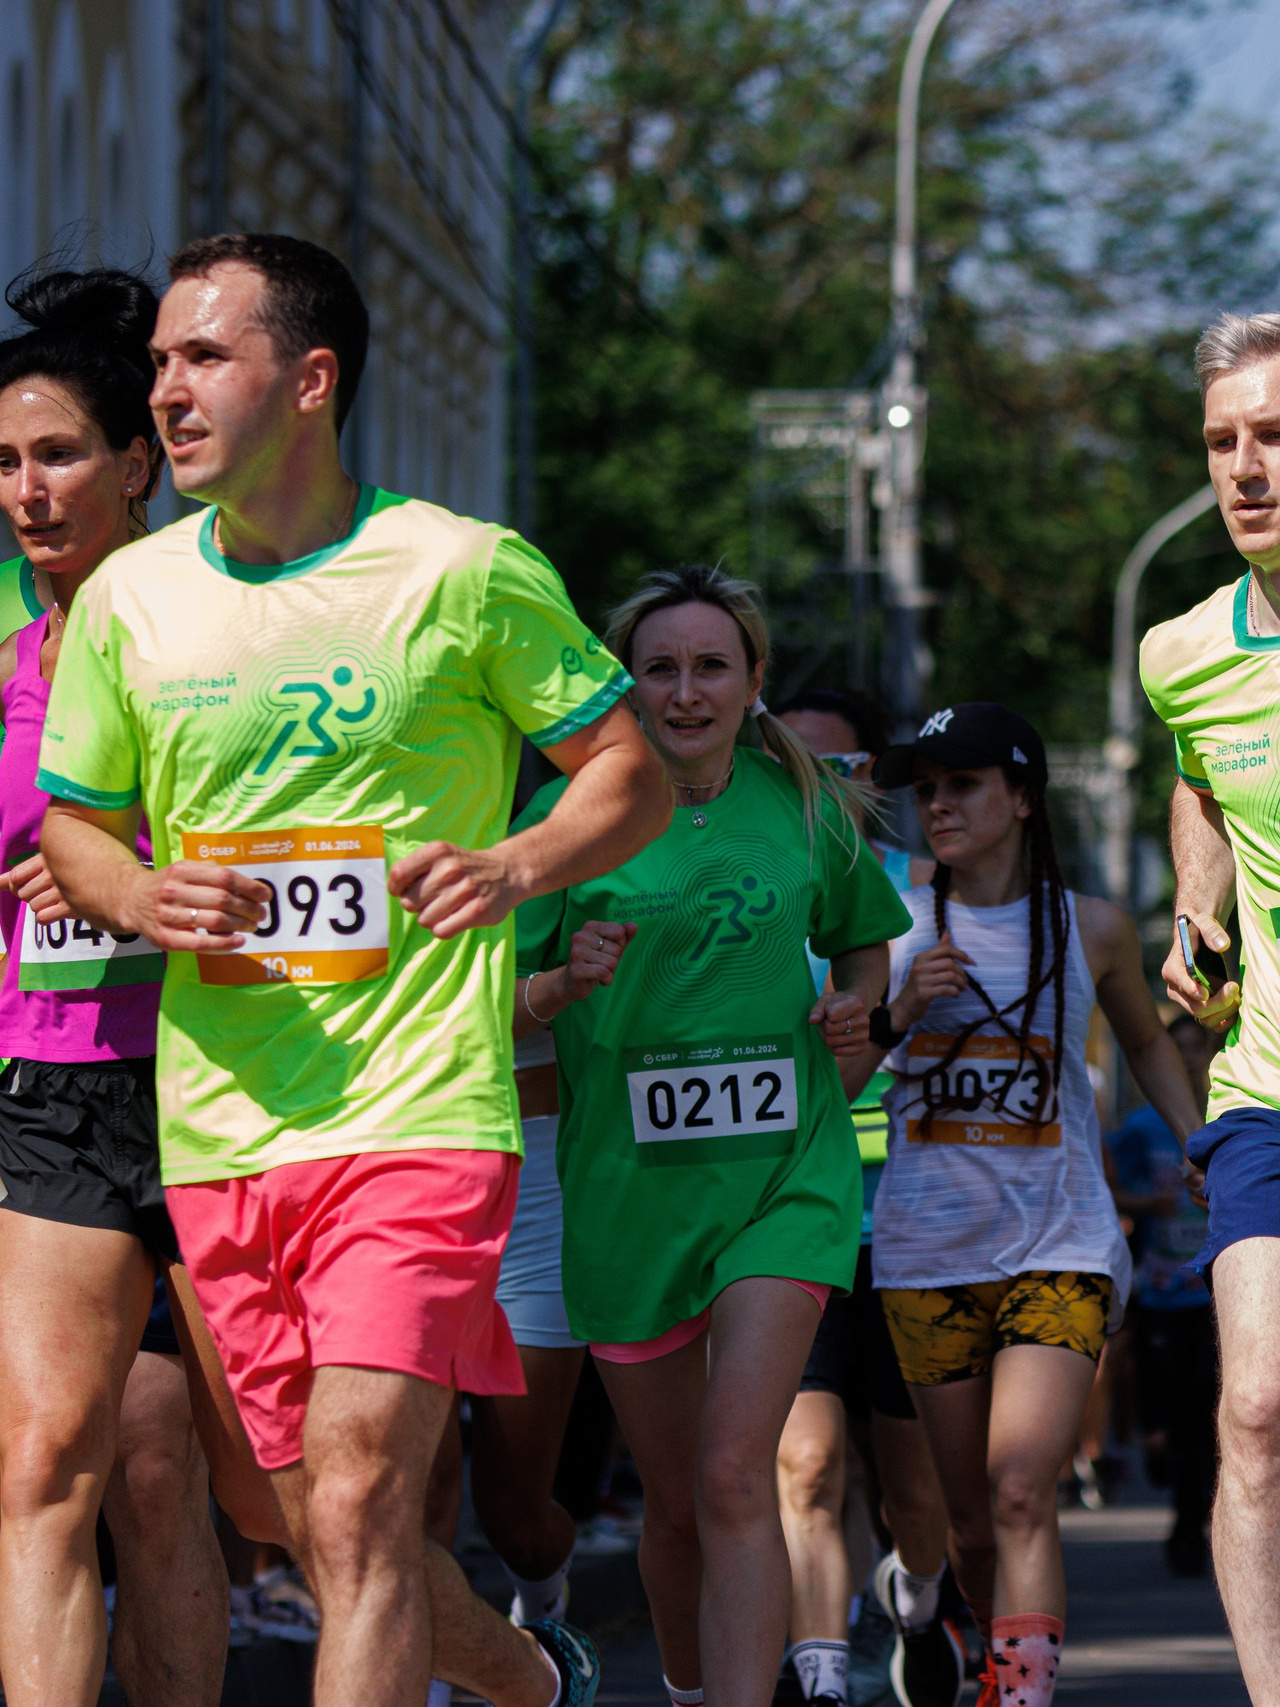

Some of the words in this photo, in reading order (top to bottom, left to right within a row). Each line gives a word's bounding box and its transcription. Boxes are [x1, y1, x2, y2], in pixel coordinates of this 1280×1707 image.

[157, 671, 237, 694] зелёный
[150, 692, 229, 712] марафон
[918, 707, 955, 738] NY
[1215, 733, 1270, 756] зелёный
[1211, 754, 1266, 775] марафон
[211, 846, 237, 856] СБЕР
[207, 874, 366, 938] 093
[617, 887, 678, 907] зелёный
[614, 903, 675, 920] марафон
[261, 957, 288, 979] 10
[655, 1053, 678, 1062] СБЕР
[733, 1044, 778, 1056] 01.06.2024
[647, 1071, 785, 1130] 0212
[923, 1068, 1043, 1113] 0073
[965, 1126, 983, 1142] 10
